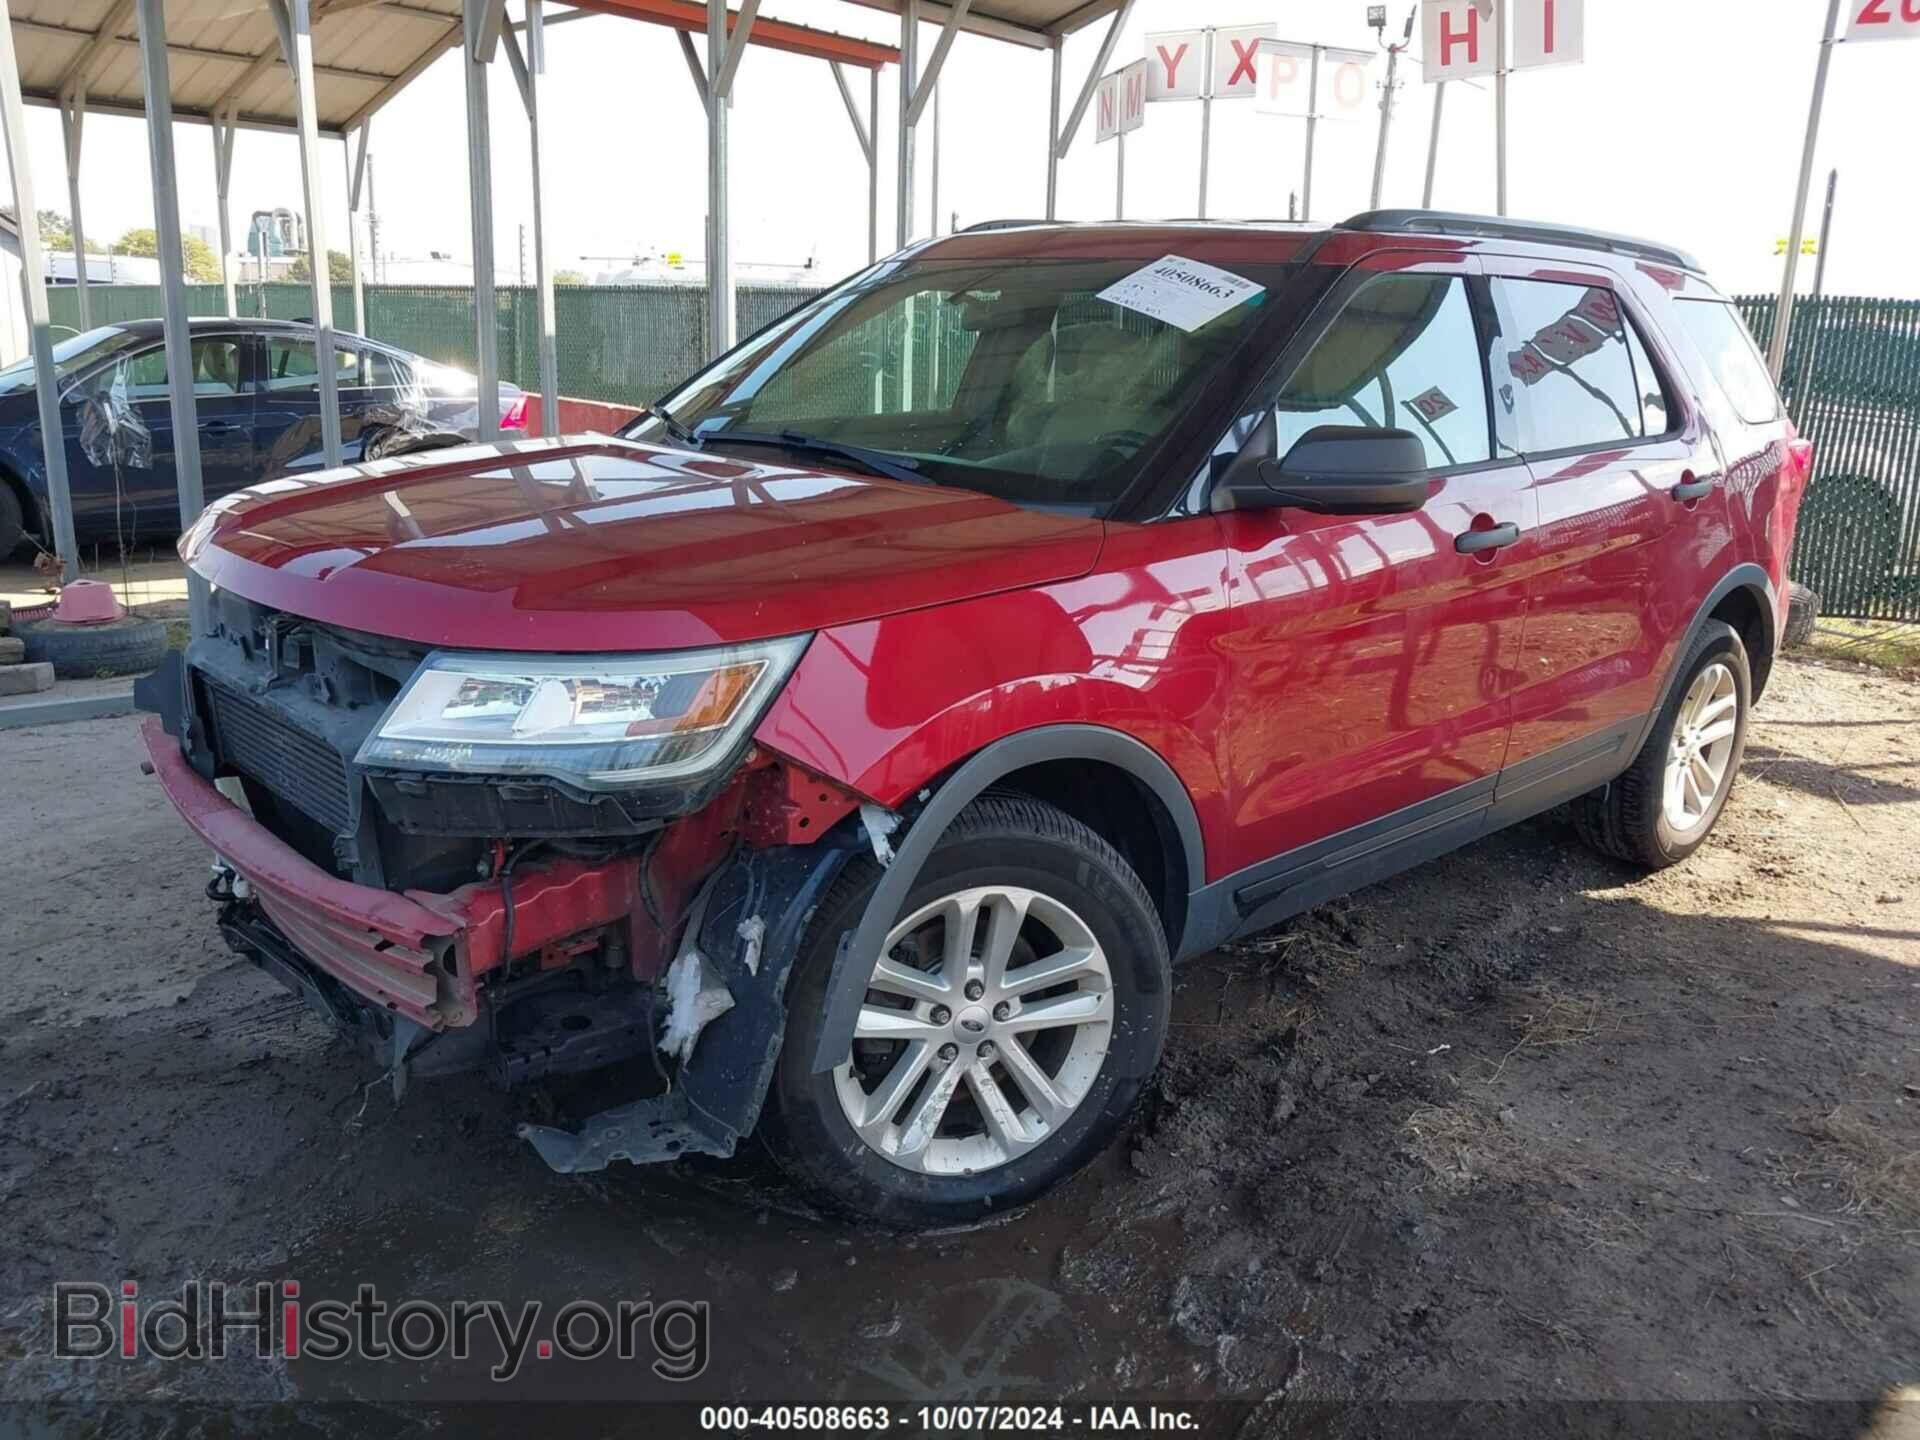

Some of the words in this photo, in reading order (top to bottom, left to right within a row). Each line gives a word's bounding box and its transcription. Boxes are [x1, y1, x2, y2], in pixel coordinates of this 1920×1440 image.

[1440, 8, 1478, 66] H
[1155, 43, 1189, 89] Y
[1227, 37, 1261, 86] X
[1271, 53, 1298, 101] P
[1153, 266, 1236, 300] 40508663
